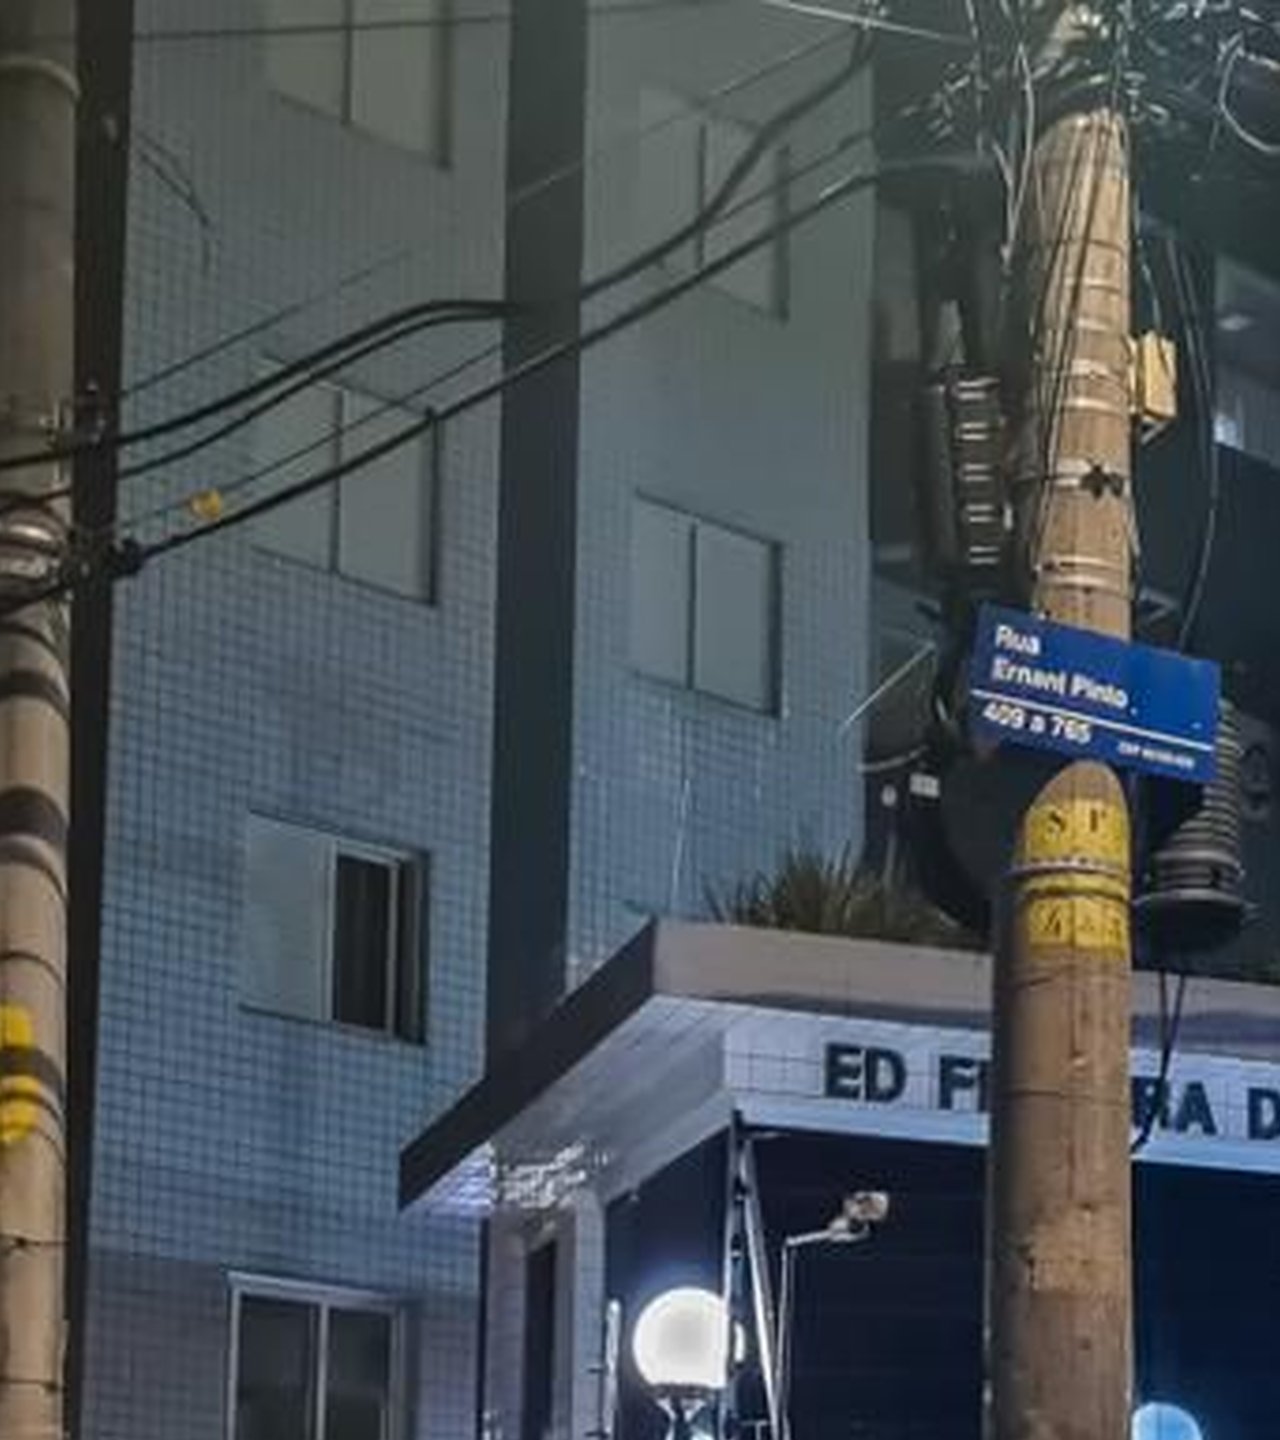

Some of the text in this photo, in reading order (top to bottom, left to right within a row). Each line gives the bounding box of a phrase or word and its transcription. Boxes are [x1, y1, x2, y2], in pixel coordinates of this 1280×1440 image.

[994, 624, 1041, 656] Rua
[1070, 672, 1129, 710] Pinto
[824, 1044, 908, 1103] ED
